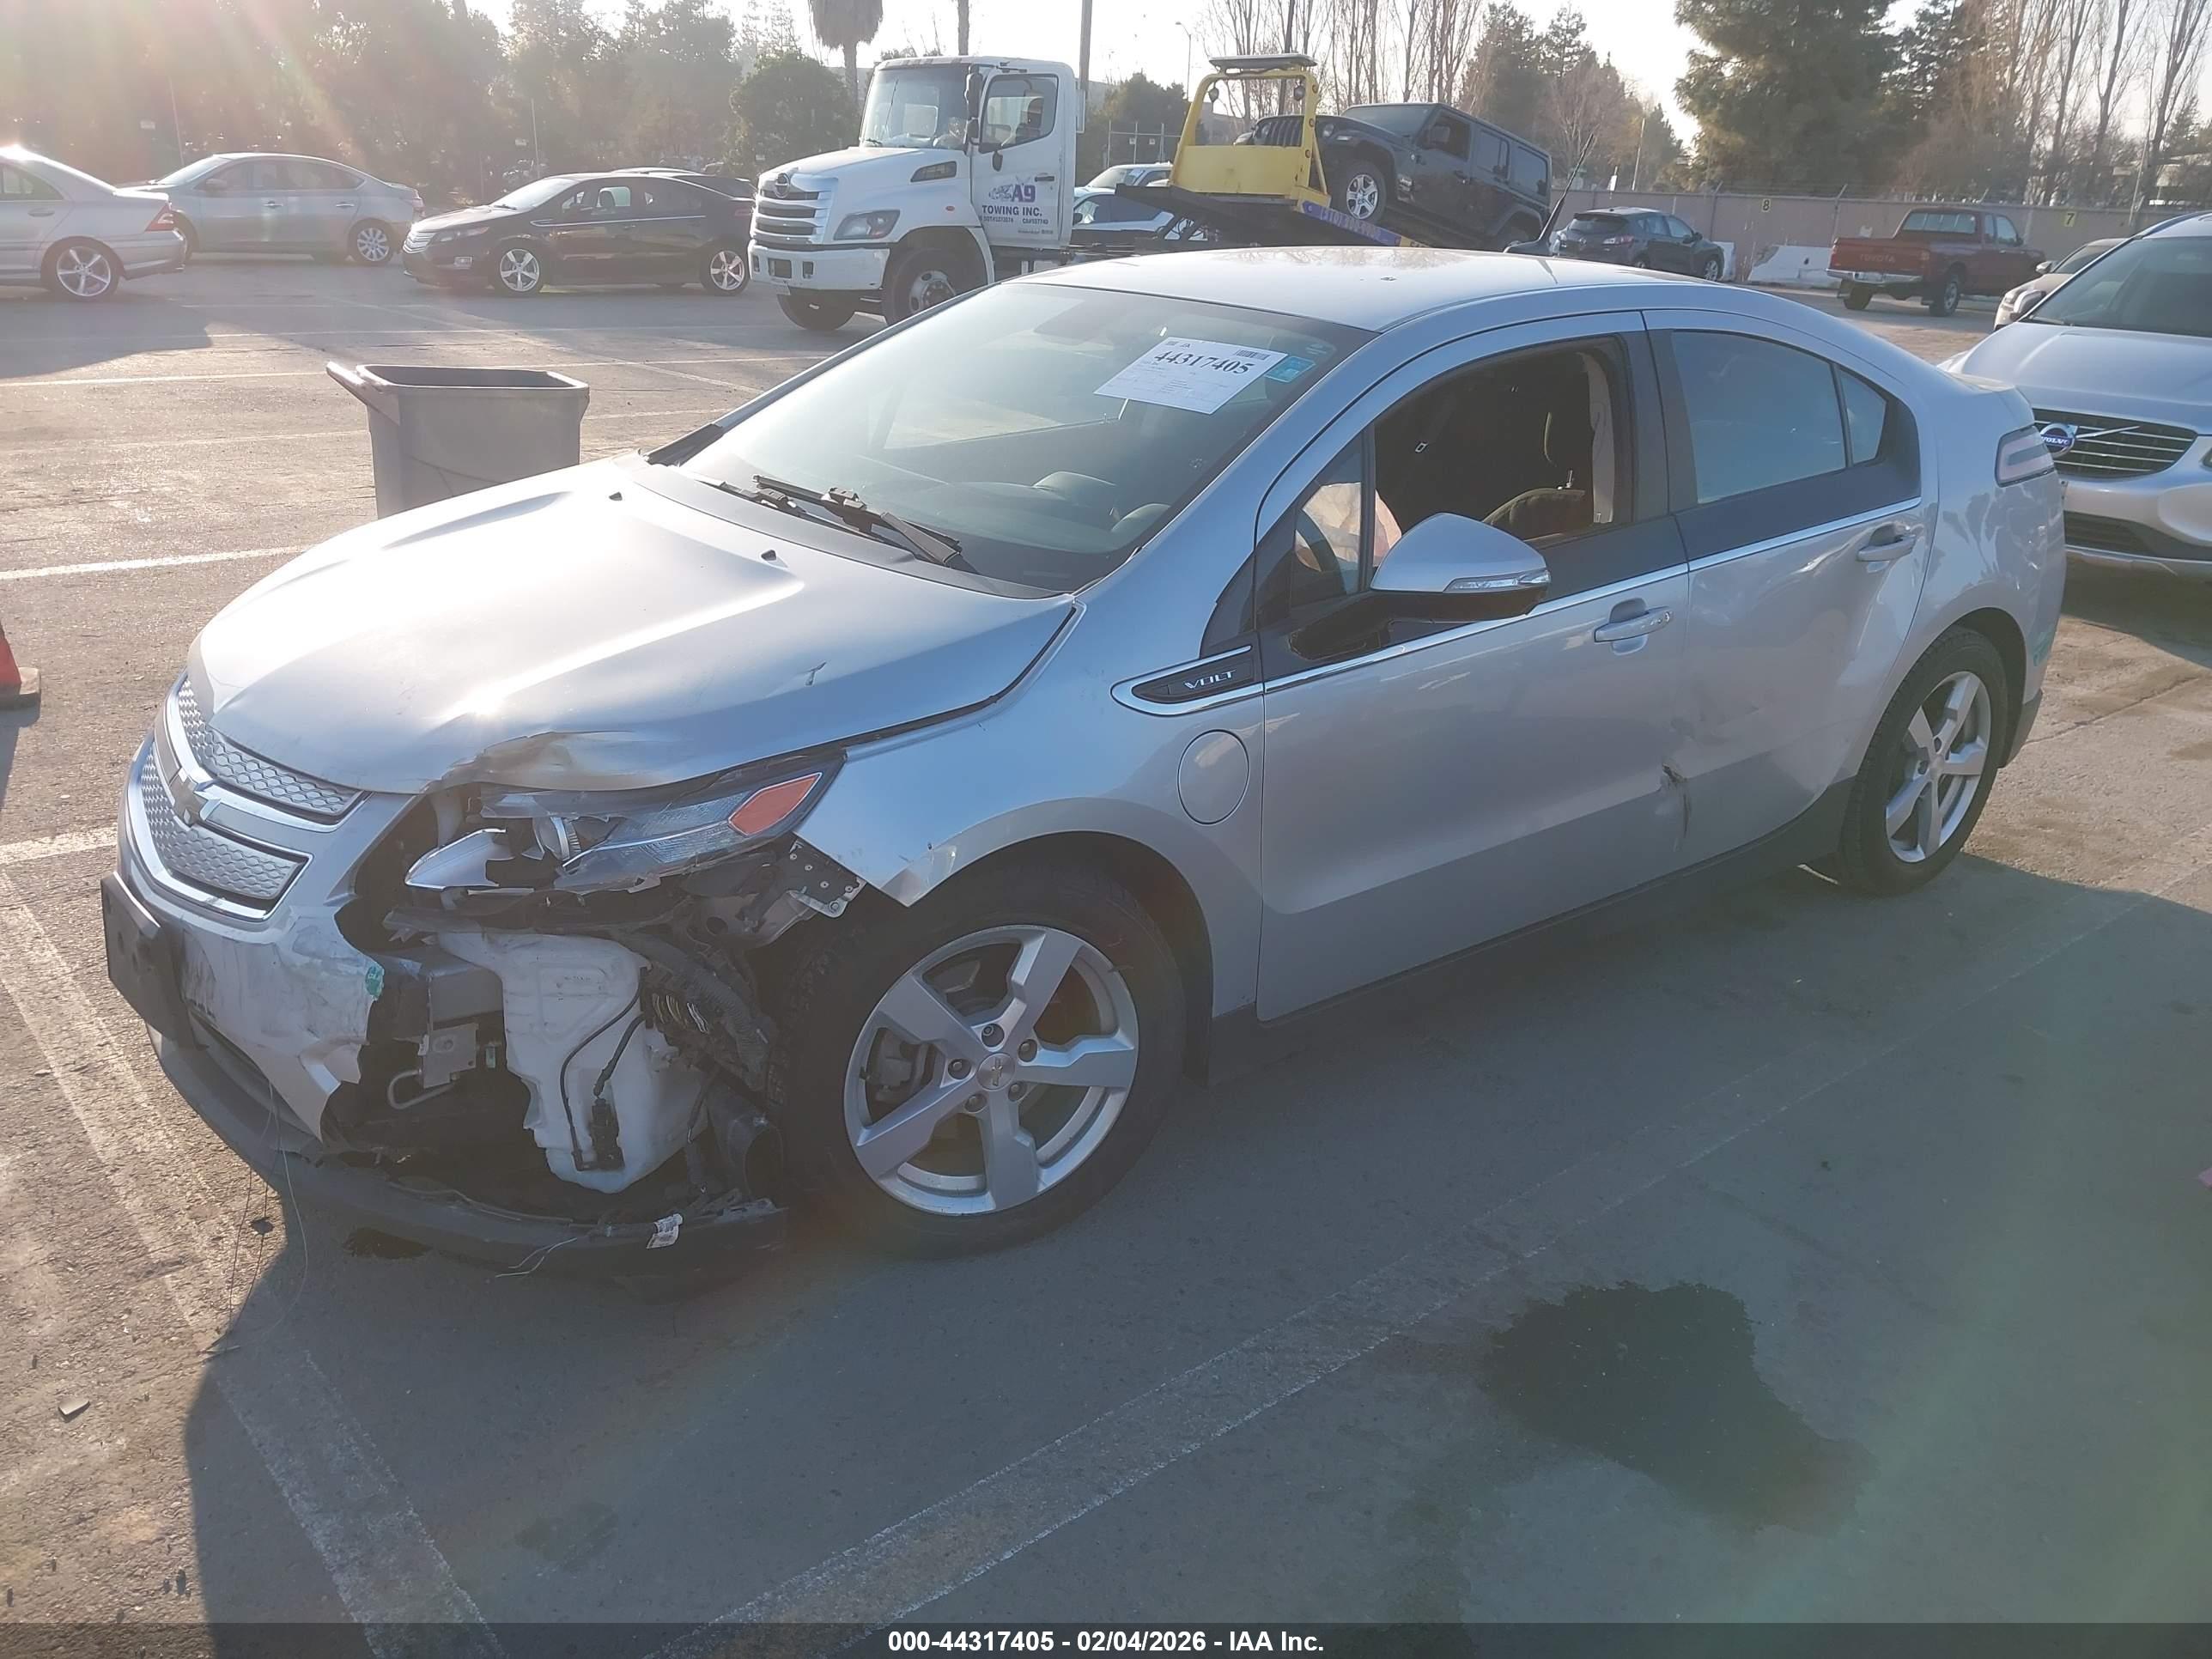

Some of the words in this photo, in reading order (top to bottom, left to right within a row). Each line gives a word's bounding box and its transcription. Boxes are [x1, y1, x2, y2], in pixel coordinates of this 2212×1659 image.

[1011, 184, 1036, 203] A9
[981, 204, 1019, 216] TOWING
[1022, 206, 1042, 217] INC.
[1762, 199, 1770, 211] 8
[2066, 212, 2075, 225] 7
[1859, 253, 1896, 264] TOYOTA
[1153, 349, 1256, 375] 44317405
[1183, 670, 1237, 689] VOLT
